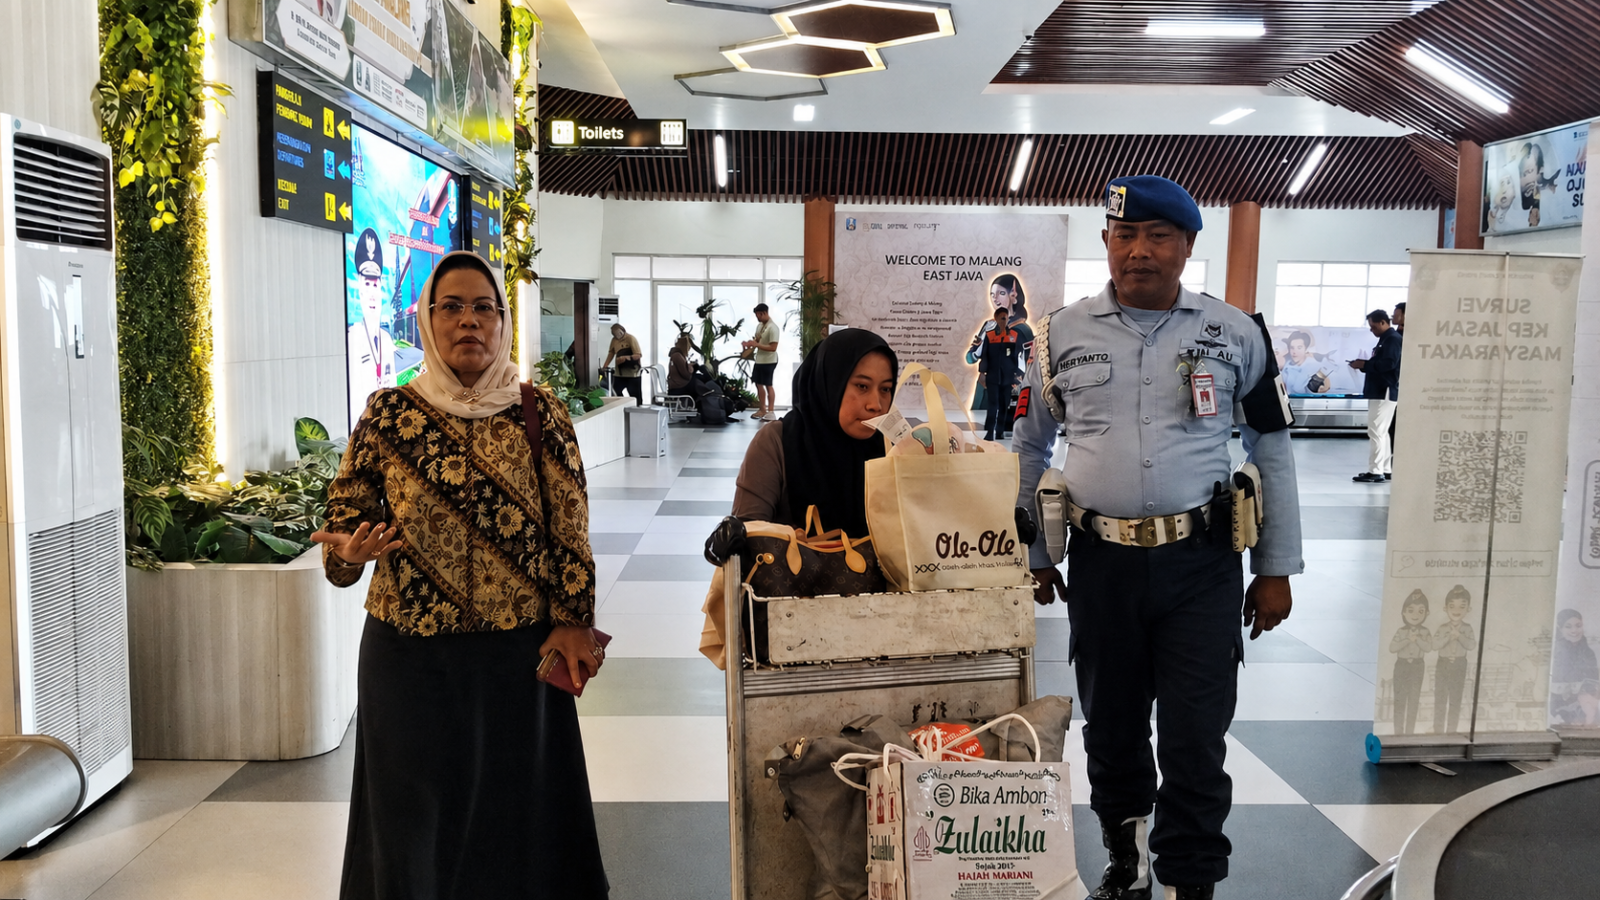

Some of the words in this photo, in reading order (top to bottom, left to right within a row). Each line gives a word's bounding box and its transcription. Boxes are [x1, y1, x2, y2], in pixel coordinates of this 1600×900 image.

[578, 126, 624, 140] Toilets
[885, 255, 946, 266] WELCOME
[949, 255, 966, 266] TO
[968, 256, 1022, 267] MALANG
[923, 270, 952, 281] EAST
[954, 271, 983, 281] JAVA
[1060, 353, 1109, 370] HERYANTO
[1217, 350, 1233, 361] AU
[935, 529, 1015, 559] Ole-Ole
[959, 785, 991, 805] Bika
[993, 785, 1047, 805] Ambon
[934, 815, 1048, 855] Zulaikha
[992, 871, 1034, 880] MARIANI
